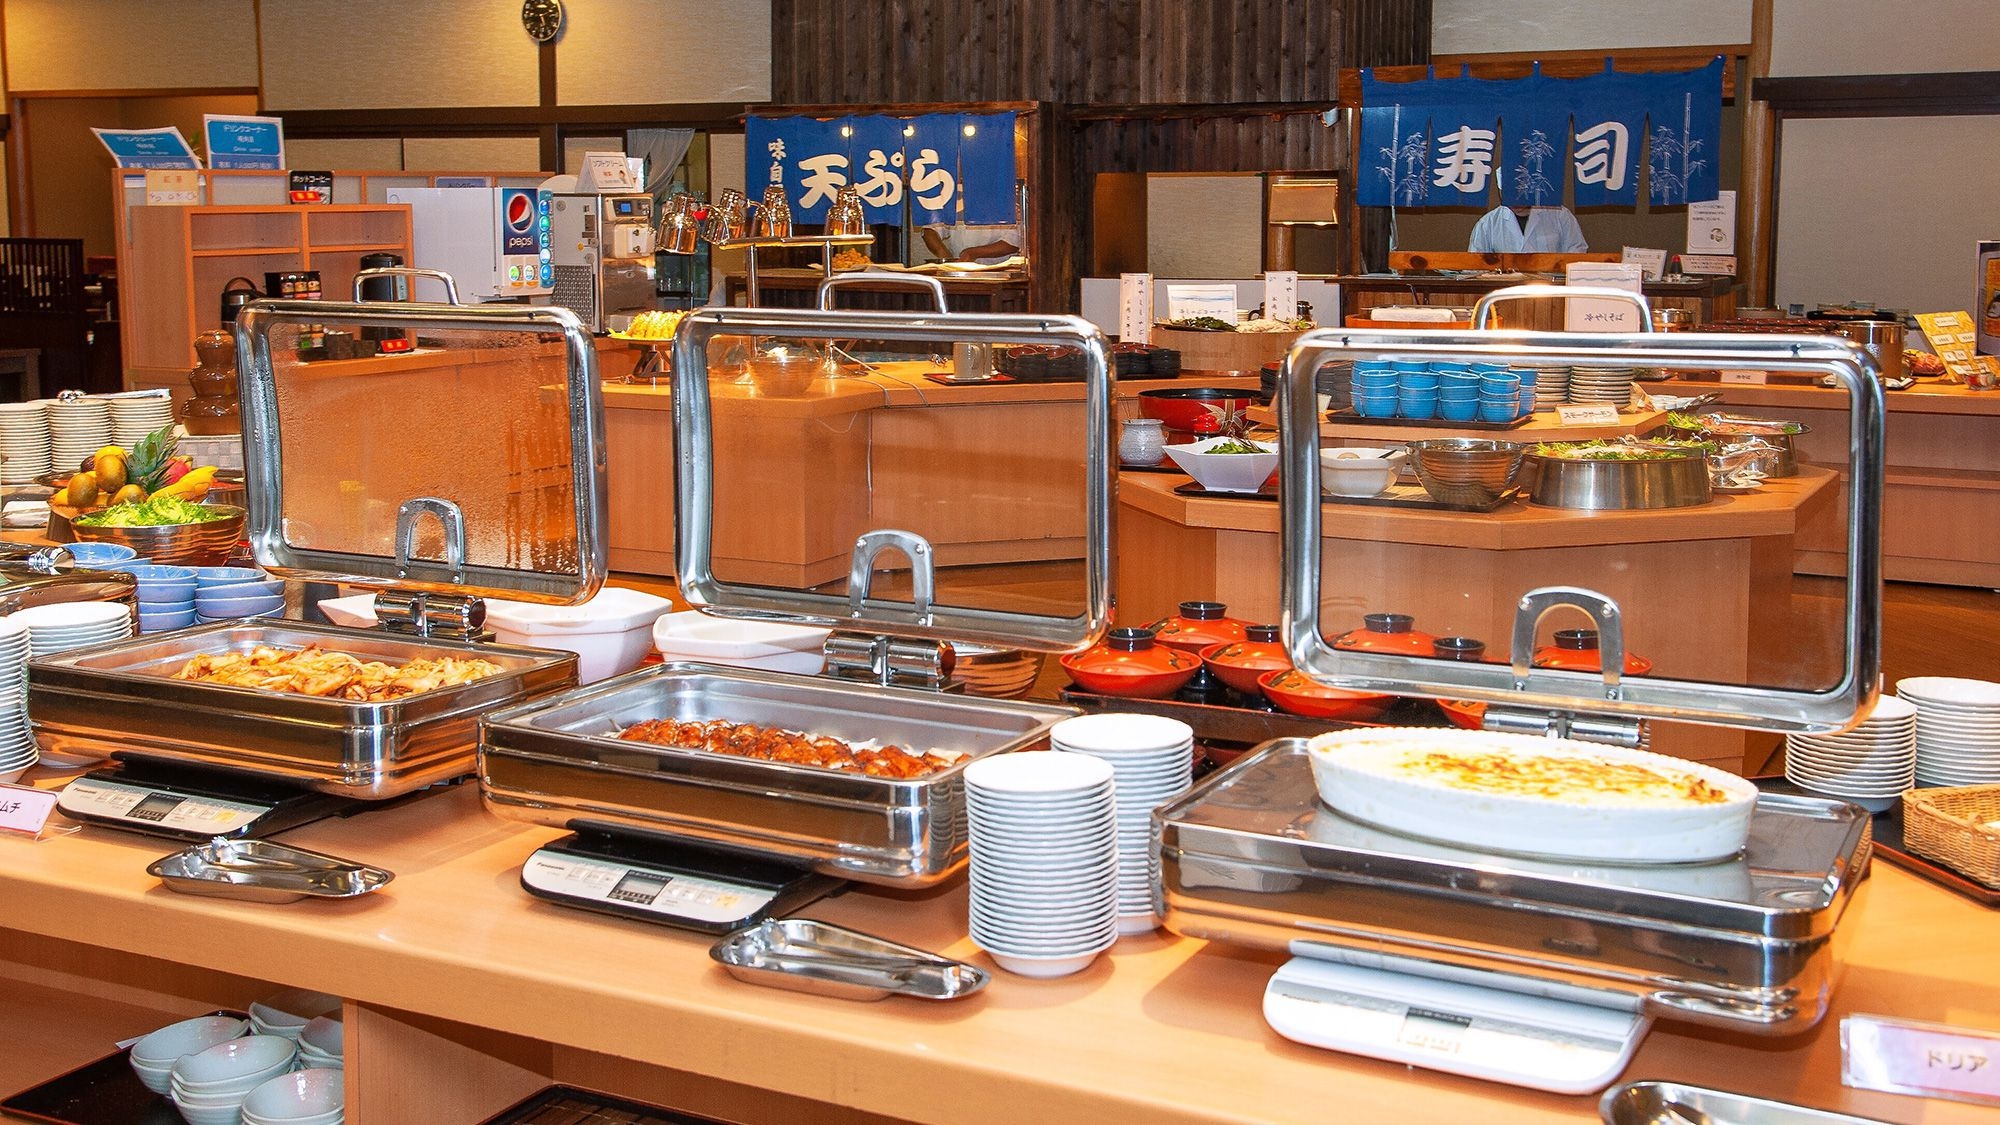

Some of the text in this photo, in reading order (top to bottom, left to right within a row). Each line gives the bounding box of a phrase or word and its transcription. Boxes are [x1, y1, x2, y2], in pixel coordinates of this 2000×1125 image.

[768, 138, 787, 188] 味自
[1433, 121, 1629, 193] 寿司
[292, 175, 331, 183] ホットコーヒー
[798, 149, 955, 210] 天ぷら
[508, 236, 534, 249] pepsi
[0, 800, 21, 814] ムチ
[1928, 1050, 1988, 1072] ドリア
